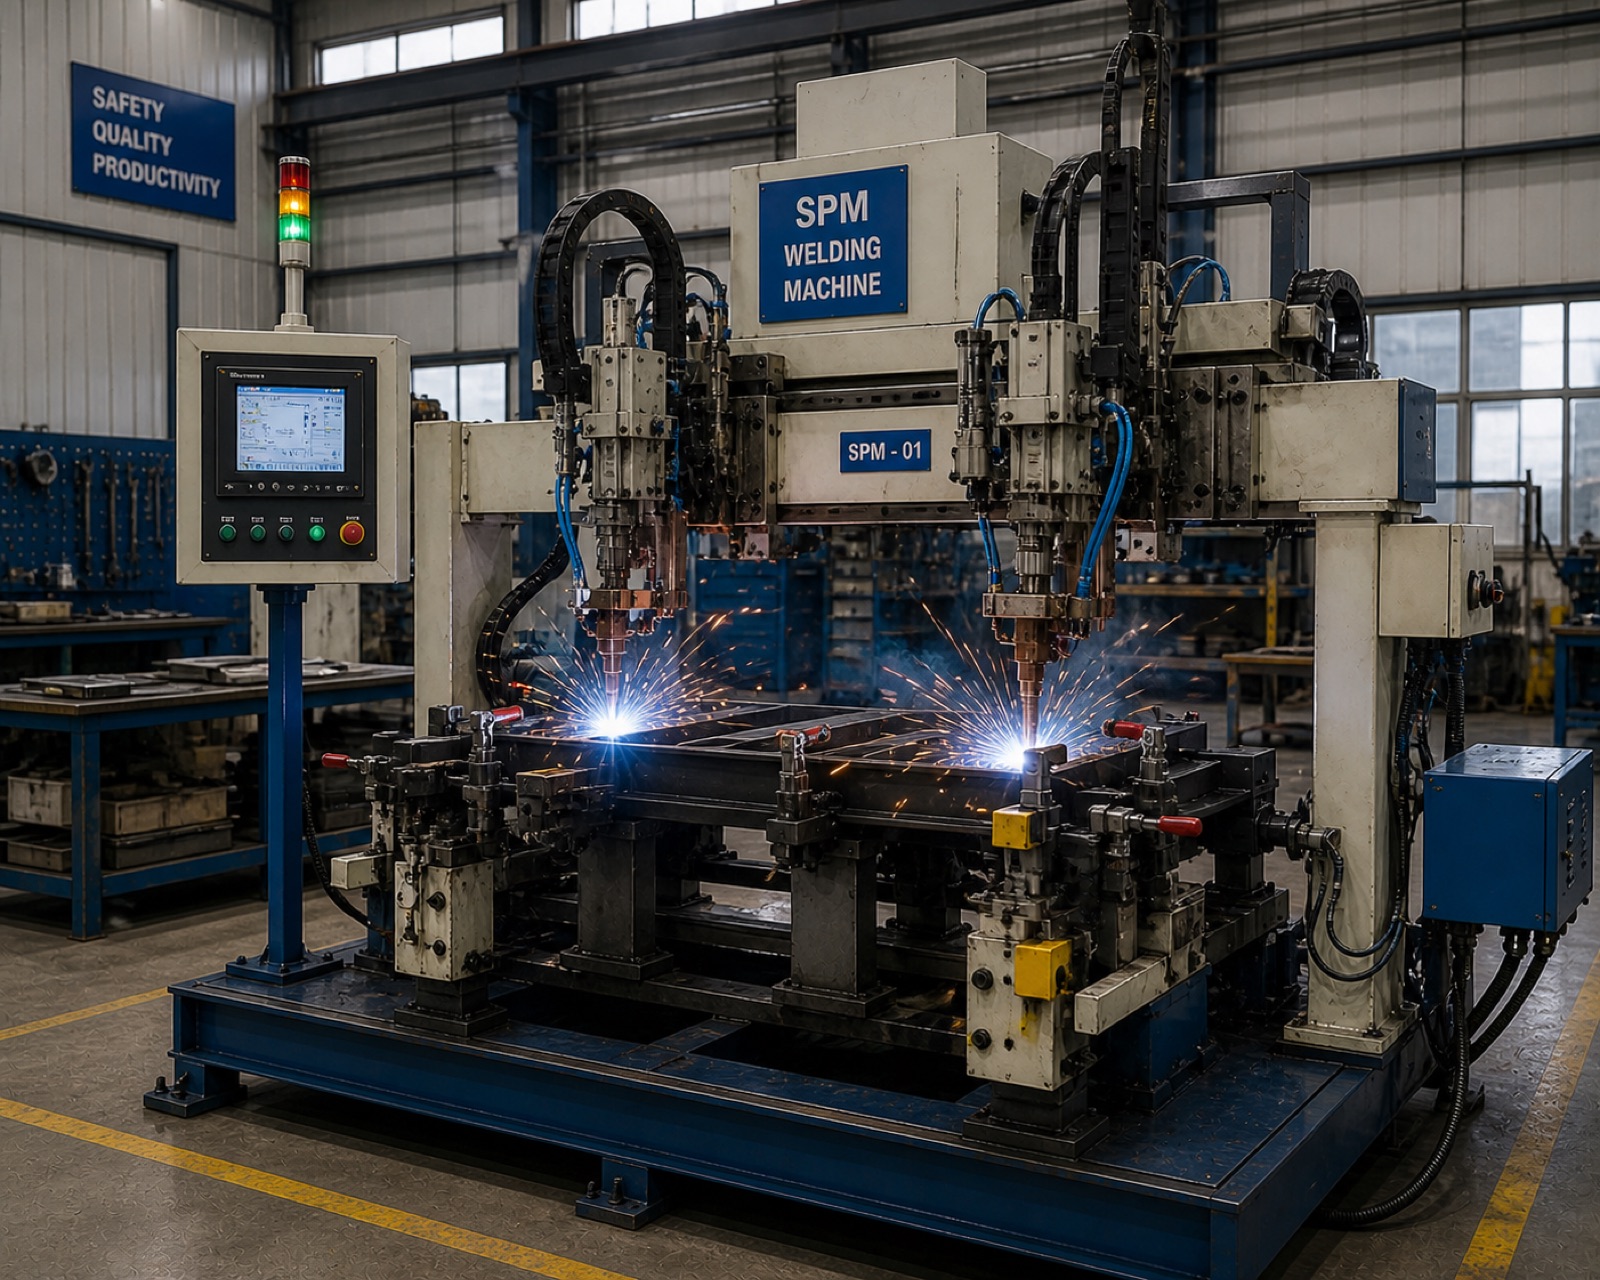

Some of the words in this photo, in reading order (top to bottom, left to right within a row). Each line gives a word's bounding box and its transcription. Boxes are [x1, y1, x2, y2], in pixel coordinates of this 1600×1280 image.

[93, 86, 164, 122] SAFETY
[93, 120, 172, 156] QUALITY
[93, 153, 220, 198] PRODUCTIVITY
[796, 189, 868, 228] SPM
[784, 235, 881, 267] WELDING
[784, 272, 881, 302] MACHINE
[848, 442, 885, 461] SPM
[902, 440, 921, 460] 01
